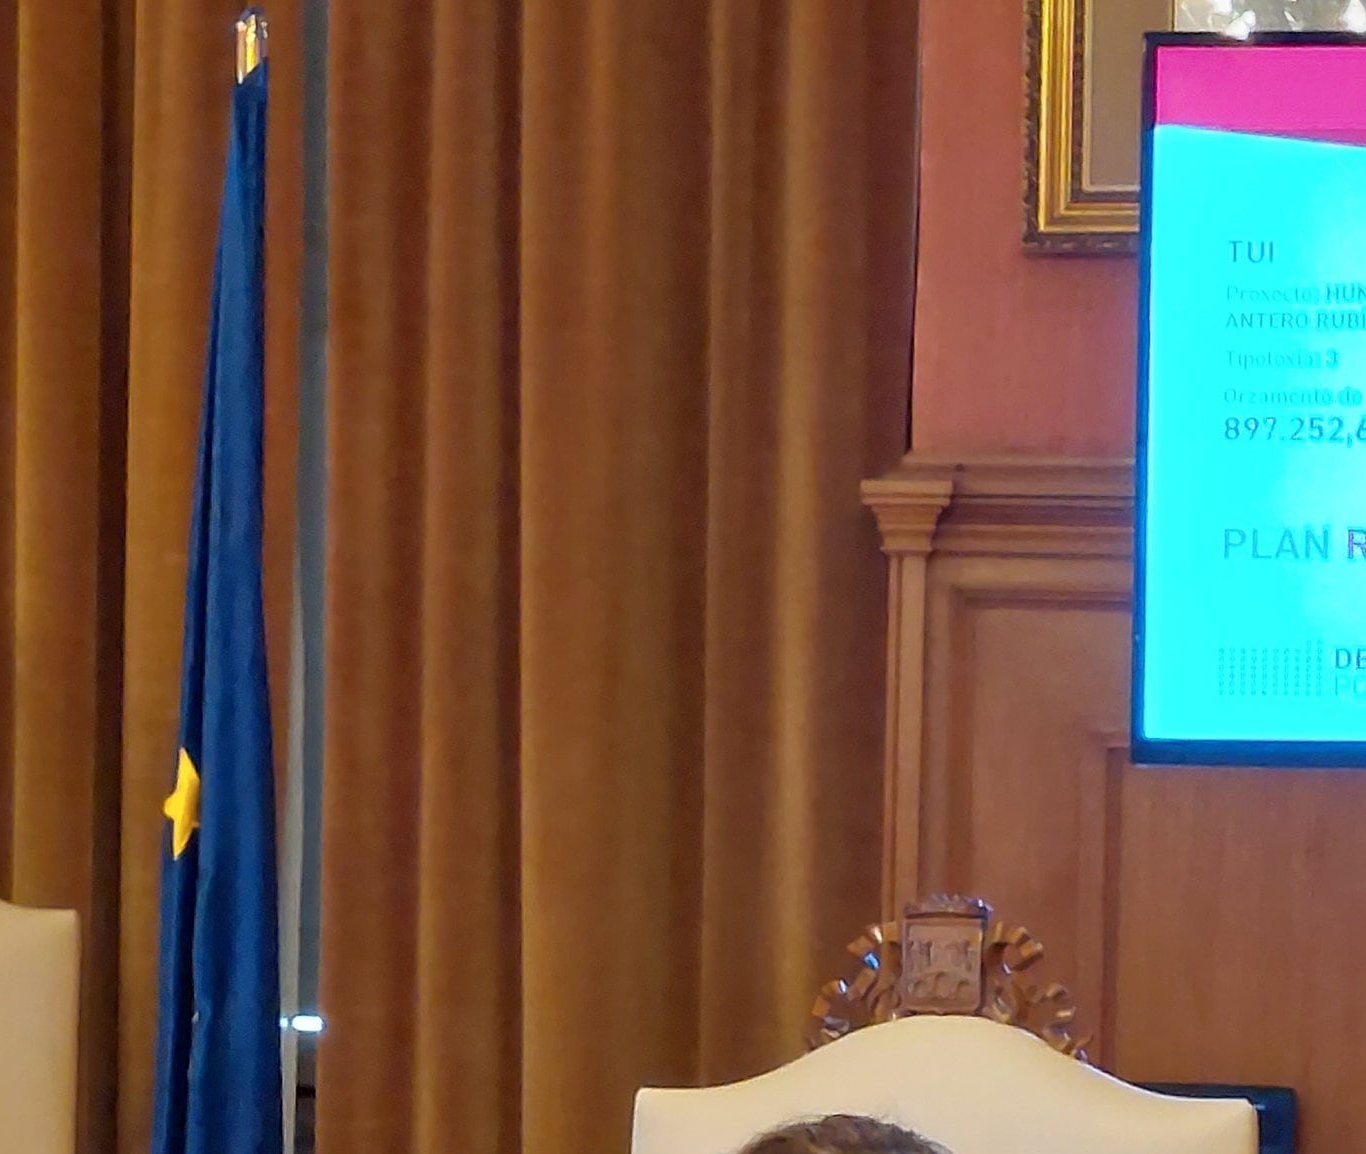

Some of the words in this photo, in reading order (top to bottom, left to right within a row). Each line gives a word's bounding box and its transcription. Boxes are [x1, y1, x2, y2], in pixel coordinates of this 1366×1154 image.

[1228, 240, 1275, 263] TUI
[1225, 312, 1309, 330] ANTERO
[1326, 349, 1339, 368] 3
[1224, 388, 1333, 405] Orzamento
[1338, 387, 1362, 406] de
[1223, 528, 1329, 559] PLAN
